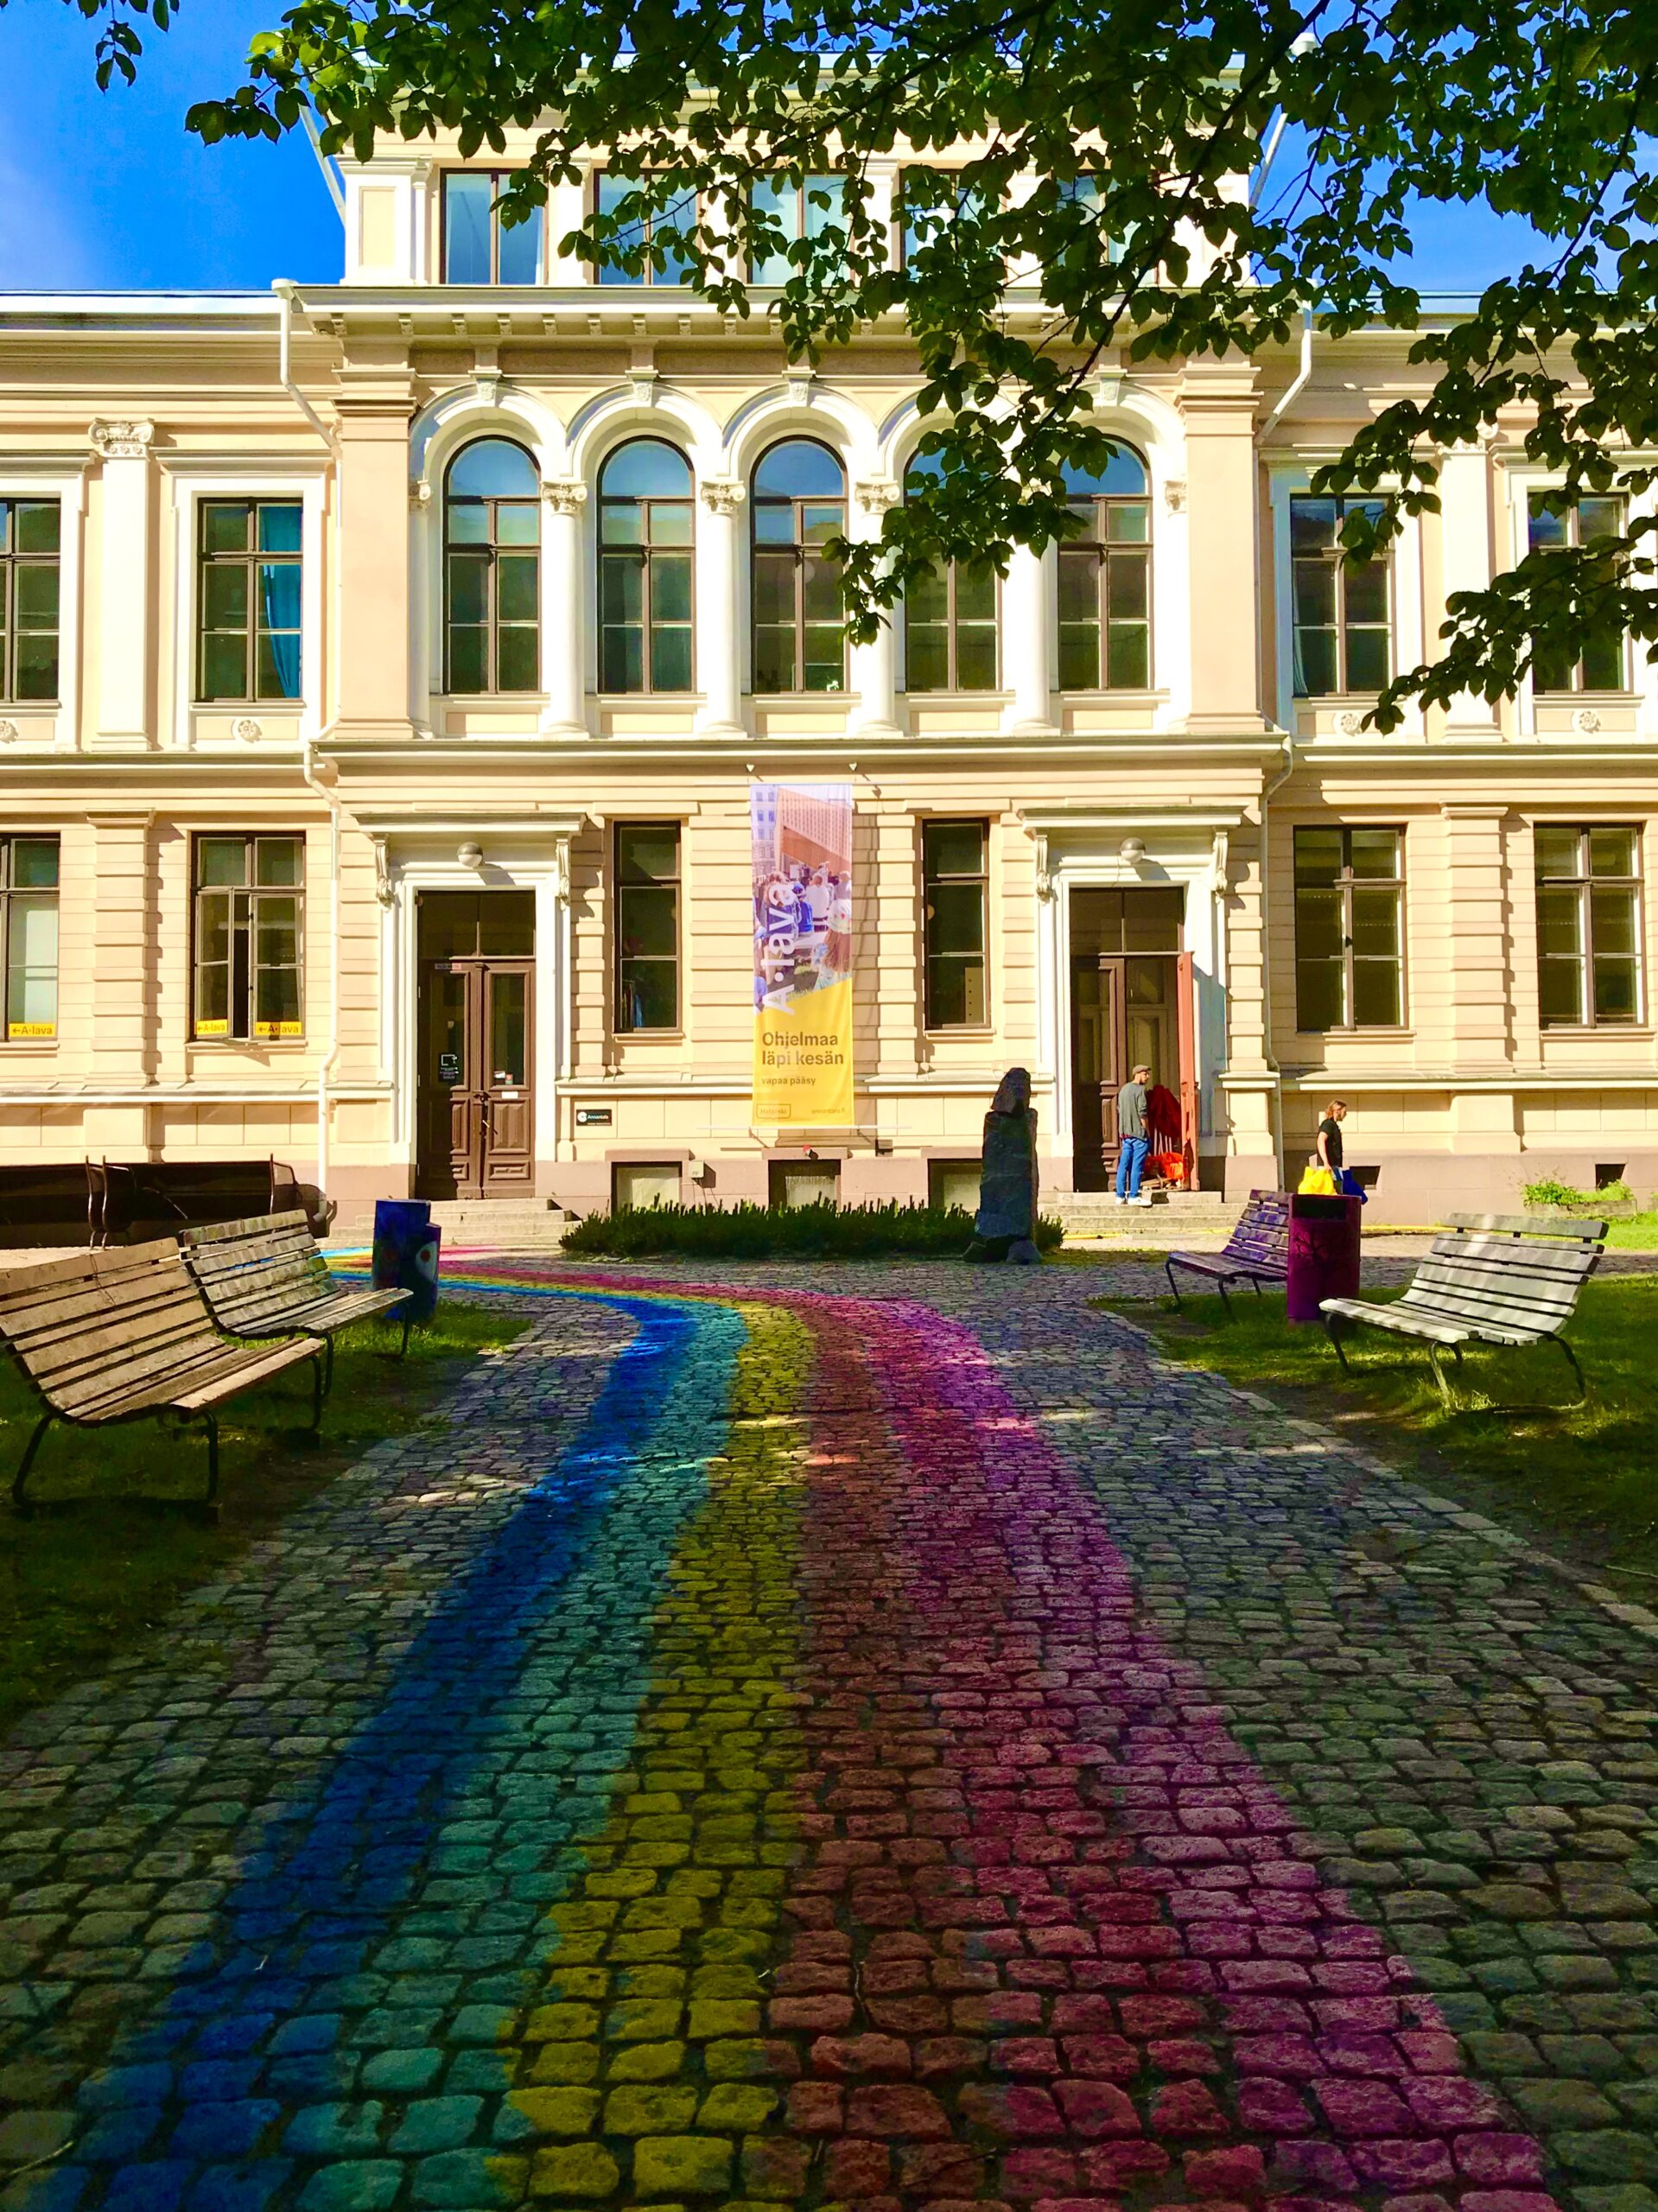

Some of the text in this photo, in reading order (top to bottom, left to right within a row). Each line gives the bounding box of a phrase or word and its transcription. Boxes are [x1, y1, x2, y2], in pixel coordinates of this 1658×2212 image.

[269, 1024, 299, 1033] A·ava
[762, 1031, 838, 1049] Ohjelmaa
[762, 1050, 844, 1069] läpi kesän
[761, 1076, 816, 1086] vapaa pääsy
